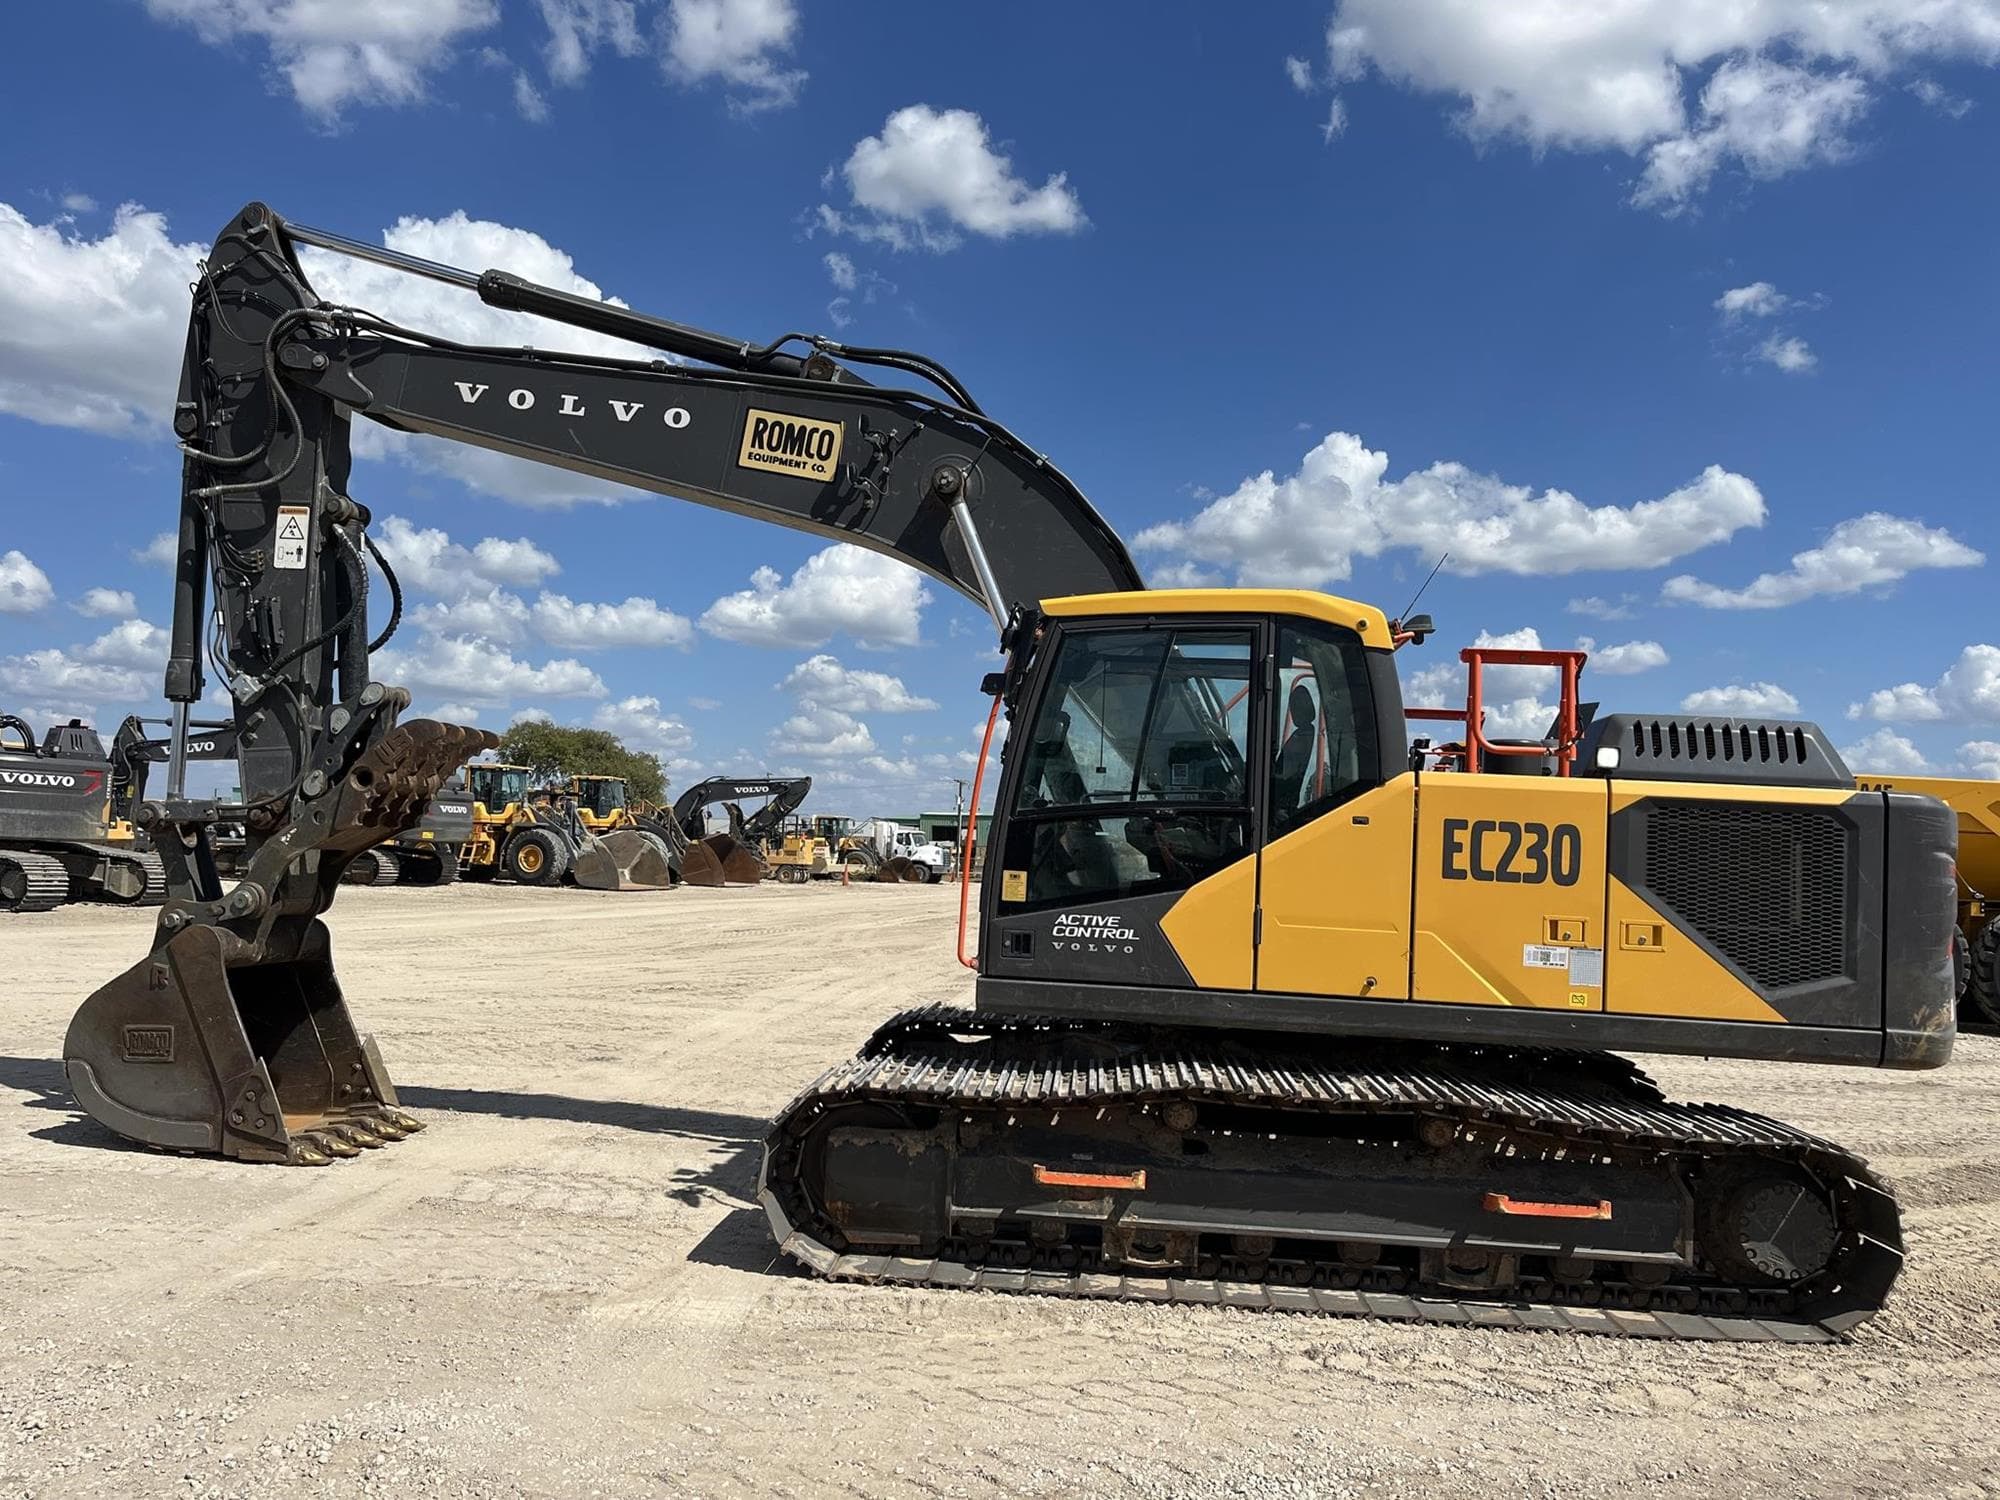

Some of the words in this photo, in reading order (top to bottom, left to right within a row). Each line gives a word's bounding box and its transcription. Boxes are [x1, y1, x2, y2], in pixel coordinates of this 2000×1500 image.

[454, 381, 691, 429] VOLVO
[750, 417, 835, 461] ROMCO
[747, 452, 808, 470] EQUIPMENT
[811, 463, 827, 474] CO.
[160, 741, 215, 755] VLVO
[0, 772, 75, 787] VOLVO
[734, 785, 769, 793] VOLVO
[439, 805, 467, 814] VOLVO
[1441, 818, 1582, 886] EC230
[1054, 914, 1121, 927] ACTIVE
[1052, 925, 1140, 940] CONTROL
[1052, 942, 1134, 954] VOLVO
